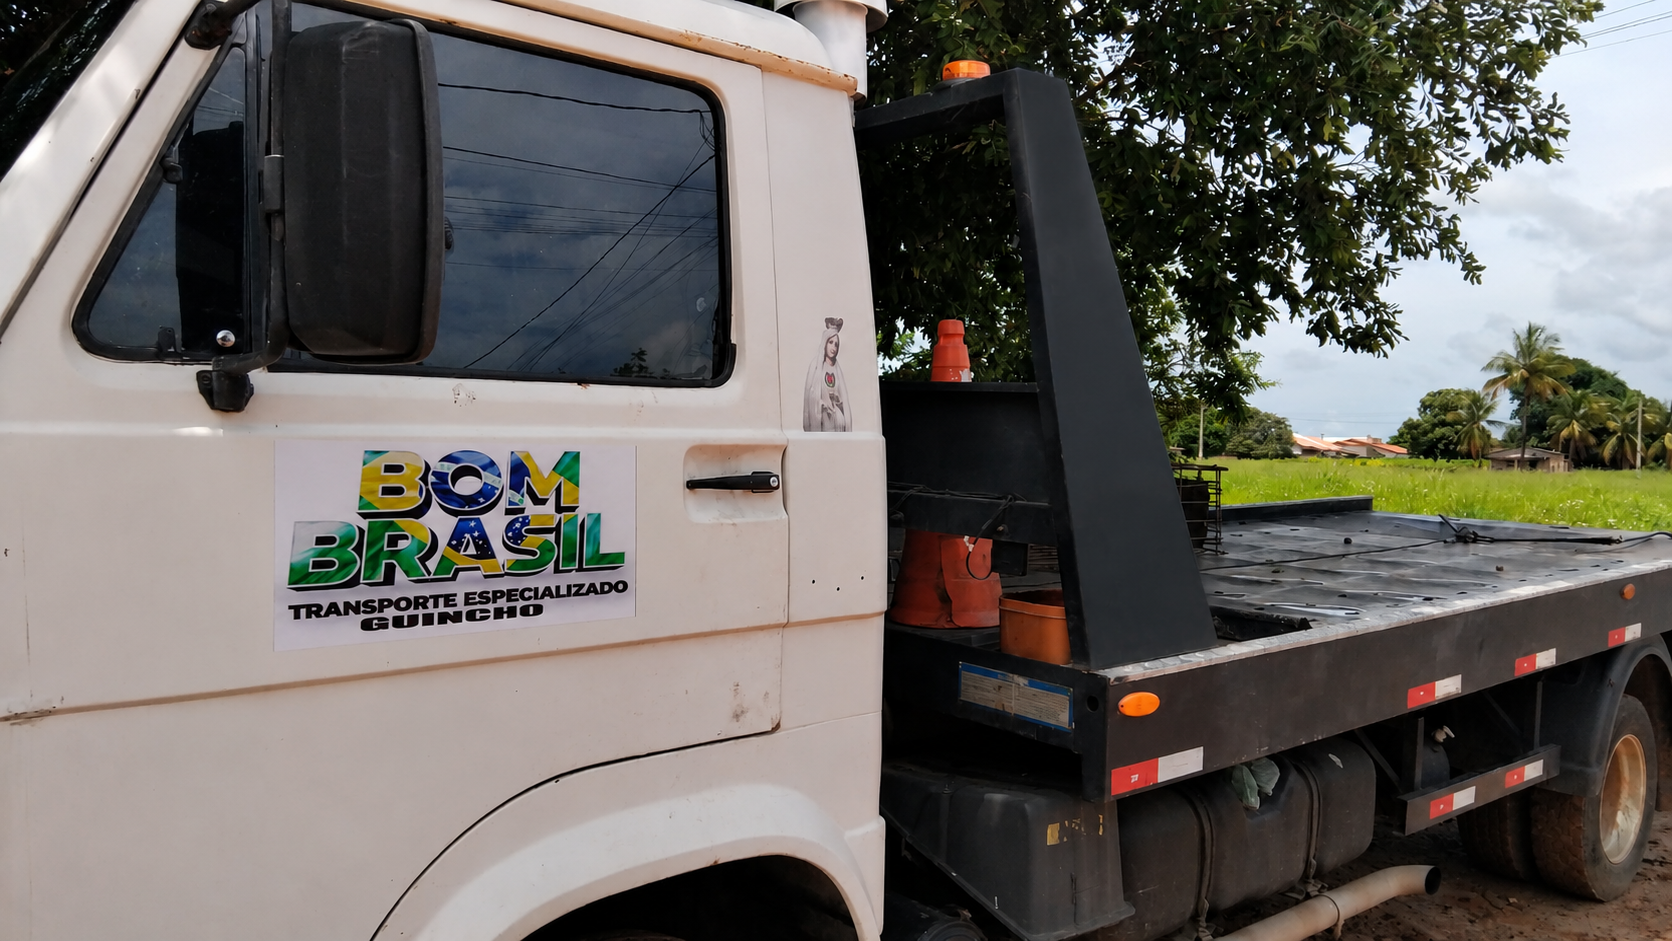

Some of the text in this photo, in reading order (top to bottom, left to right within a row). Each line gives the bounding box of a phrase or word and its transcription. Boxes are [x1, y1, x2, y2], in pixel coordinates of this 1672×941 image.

[357, 450, 581, 518] BOM
[287, 512, 625, 591] BRASIL
[288, 580, 629, 620] TRANSPORTE ESPECIALIZADO
[360, 604, 544, 631] GUINCHO
